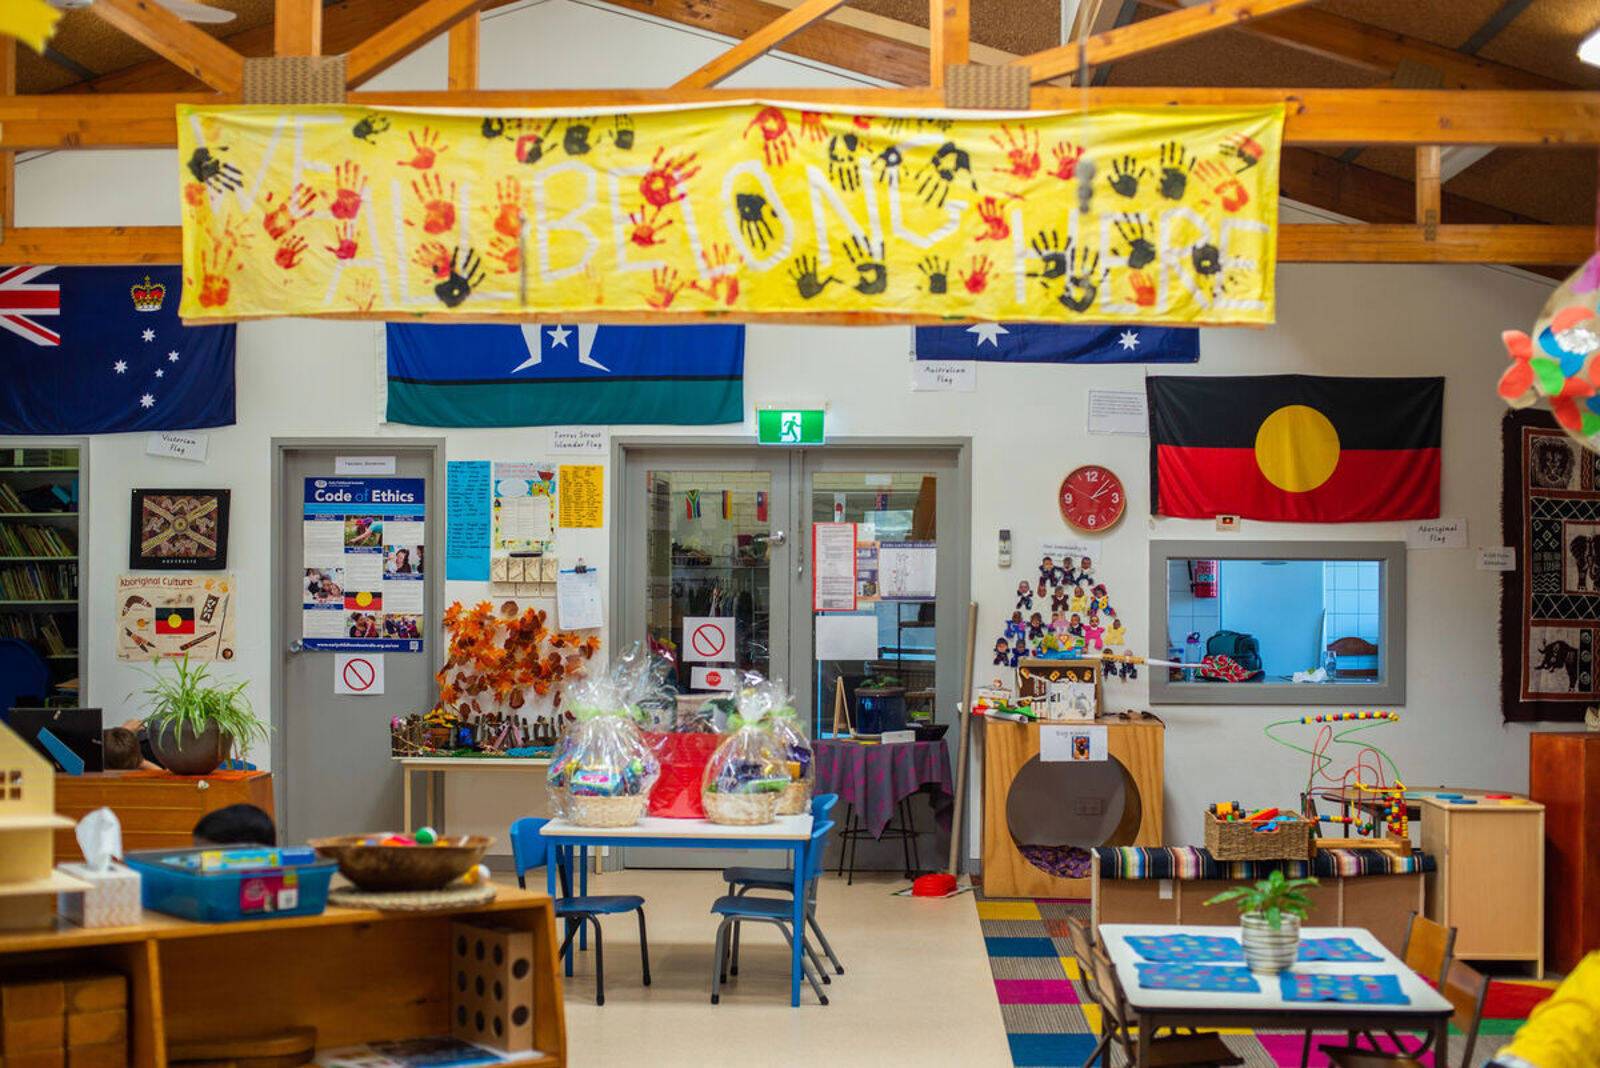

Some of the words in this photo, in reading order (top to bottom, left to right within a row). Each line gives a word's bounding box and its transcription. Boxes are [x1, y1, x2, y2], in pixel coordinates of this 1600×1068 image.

[189, 113, 344, 222] WE
[325, 176, 518, 308] ALL
[535, 132, 969, 284] BELONG
[1010, 204, 1271, 315] HERE
[1085, 471, 1098, 482] 12
[315, 489, 352, 502] Code
[355, 489, 369, 502] of
[371, 489, 414, 502] Ethics
[1064, 493, 1073, 503] 9
[1111, 493, 1119, 503] 3
[1088, 515, 1096, 526] 6
[120, 577, 160, 587] Aboriginal
[162, 577, 193, 586] Culture
